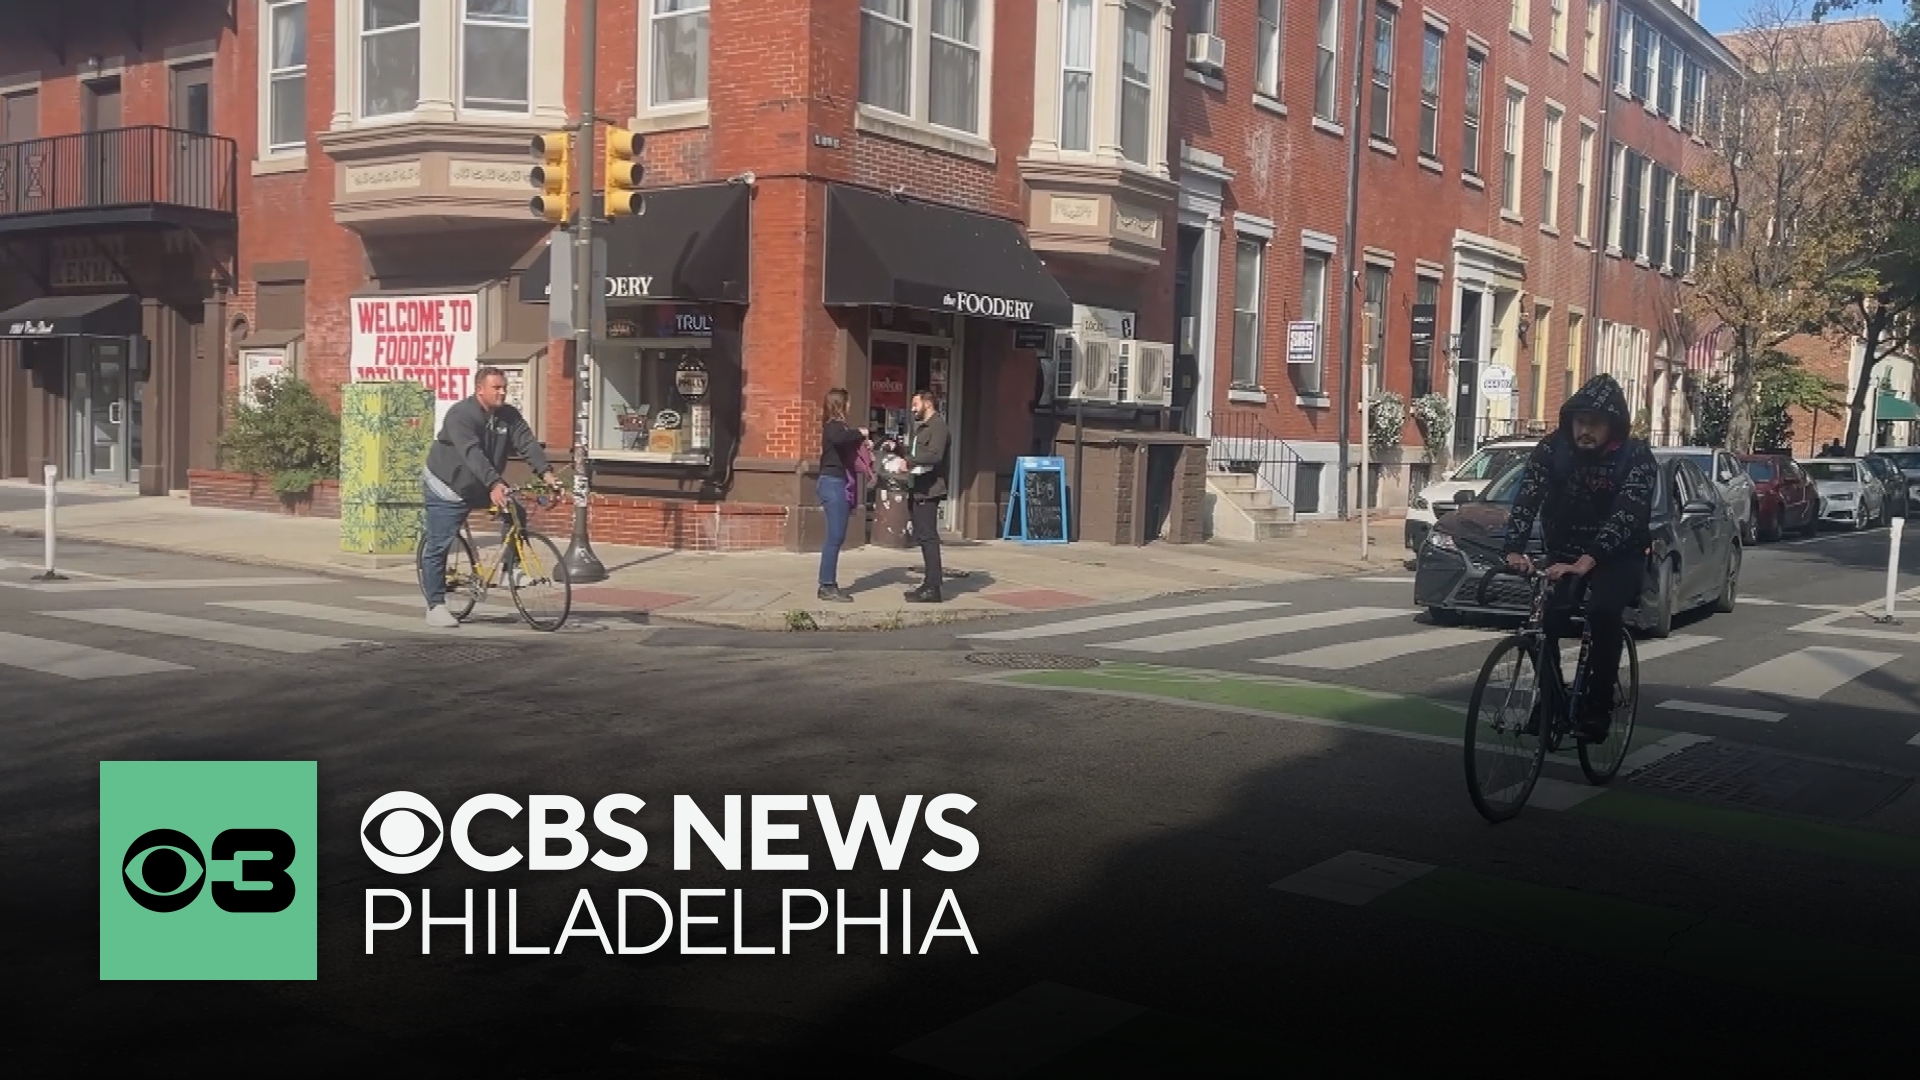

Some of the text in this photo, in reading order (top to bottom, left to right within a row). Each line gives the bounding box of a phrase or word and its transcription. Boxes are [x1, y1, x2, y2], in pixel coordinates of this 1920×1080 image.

[605, 276, 653, 297] DERY
[357, 299, 472, 334] WELCOME TO
[943, 291, 1034, 320] the FOODERY
[375, 334, 455, 366] FOODERY
